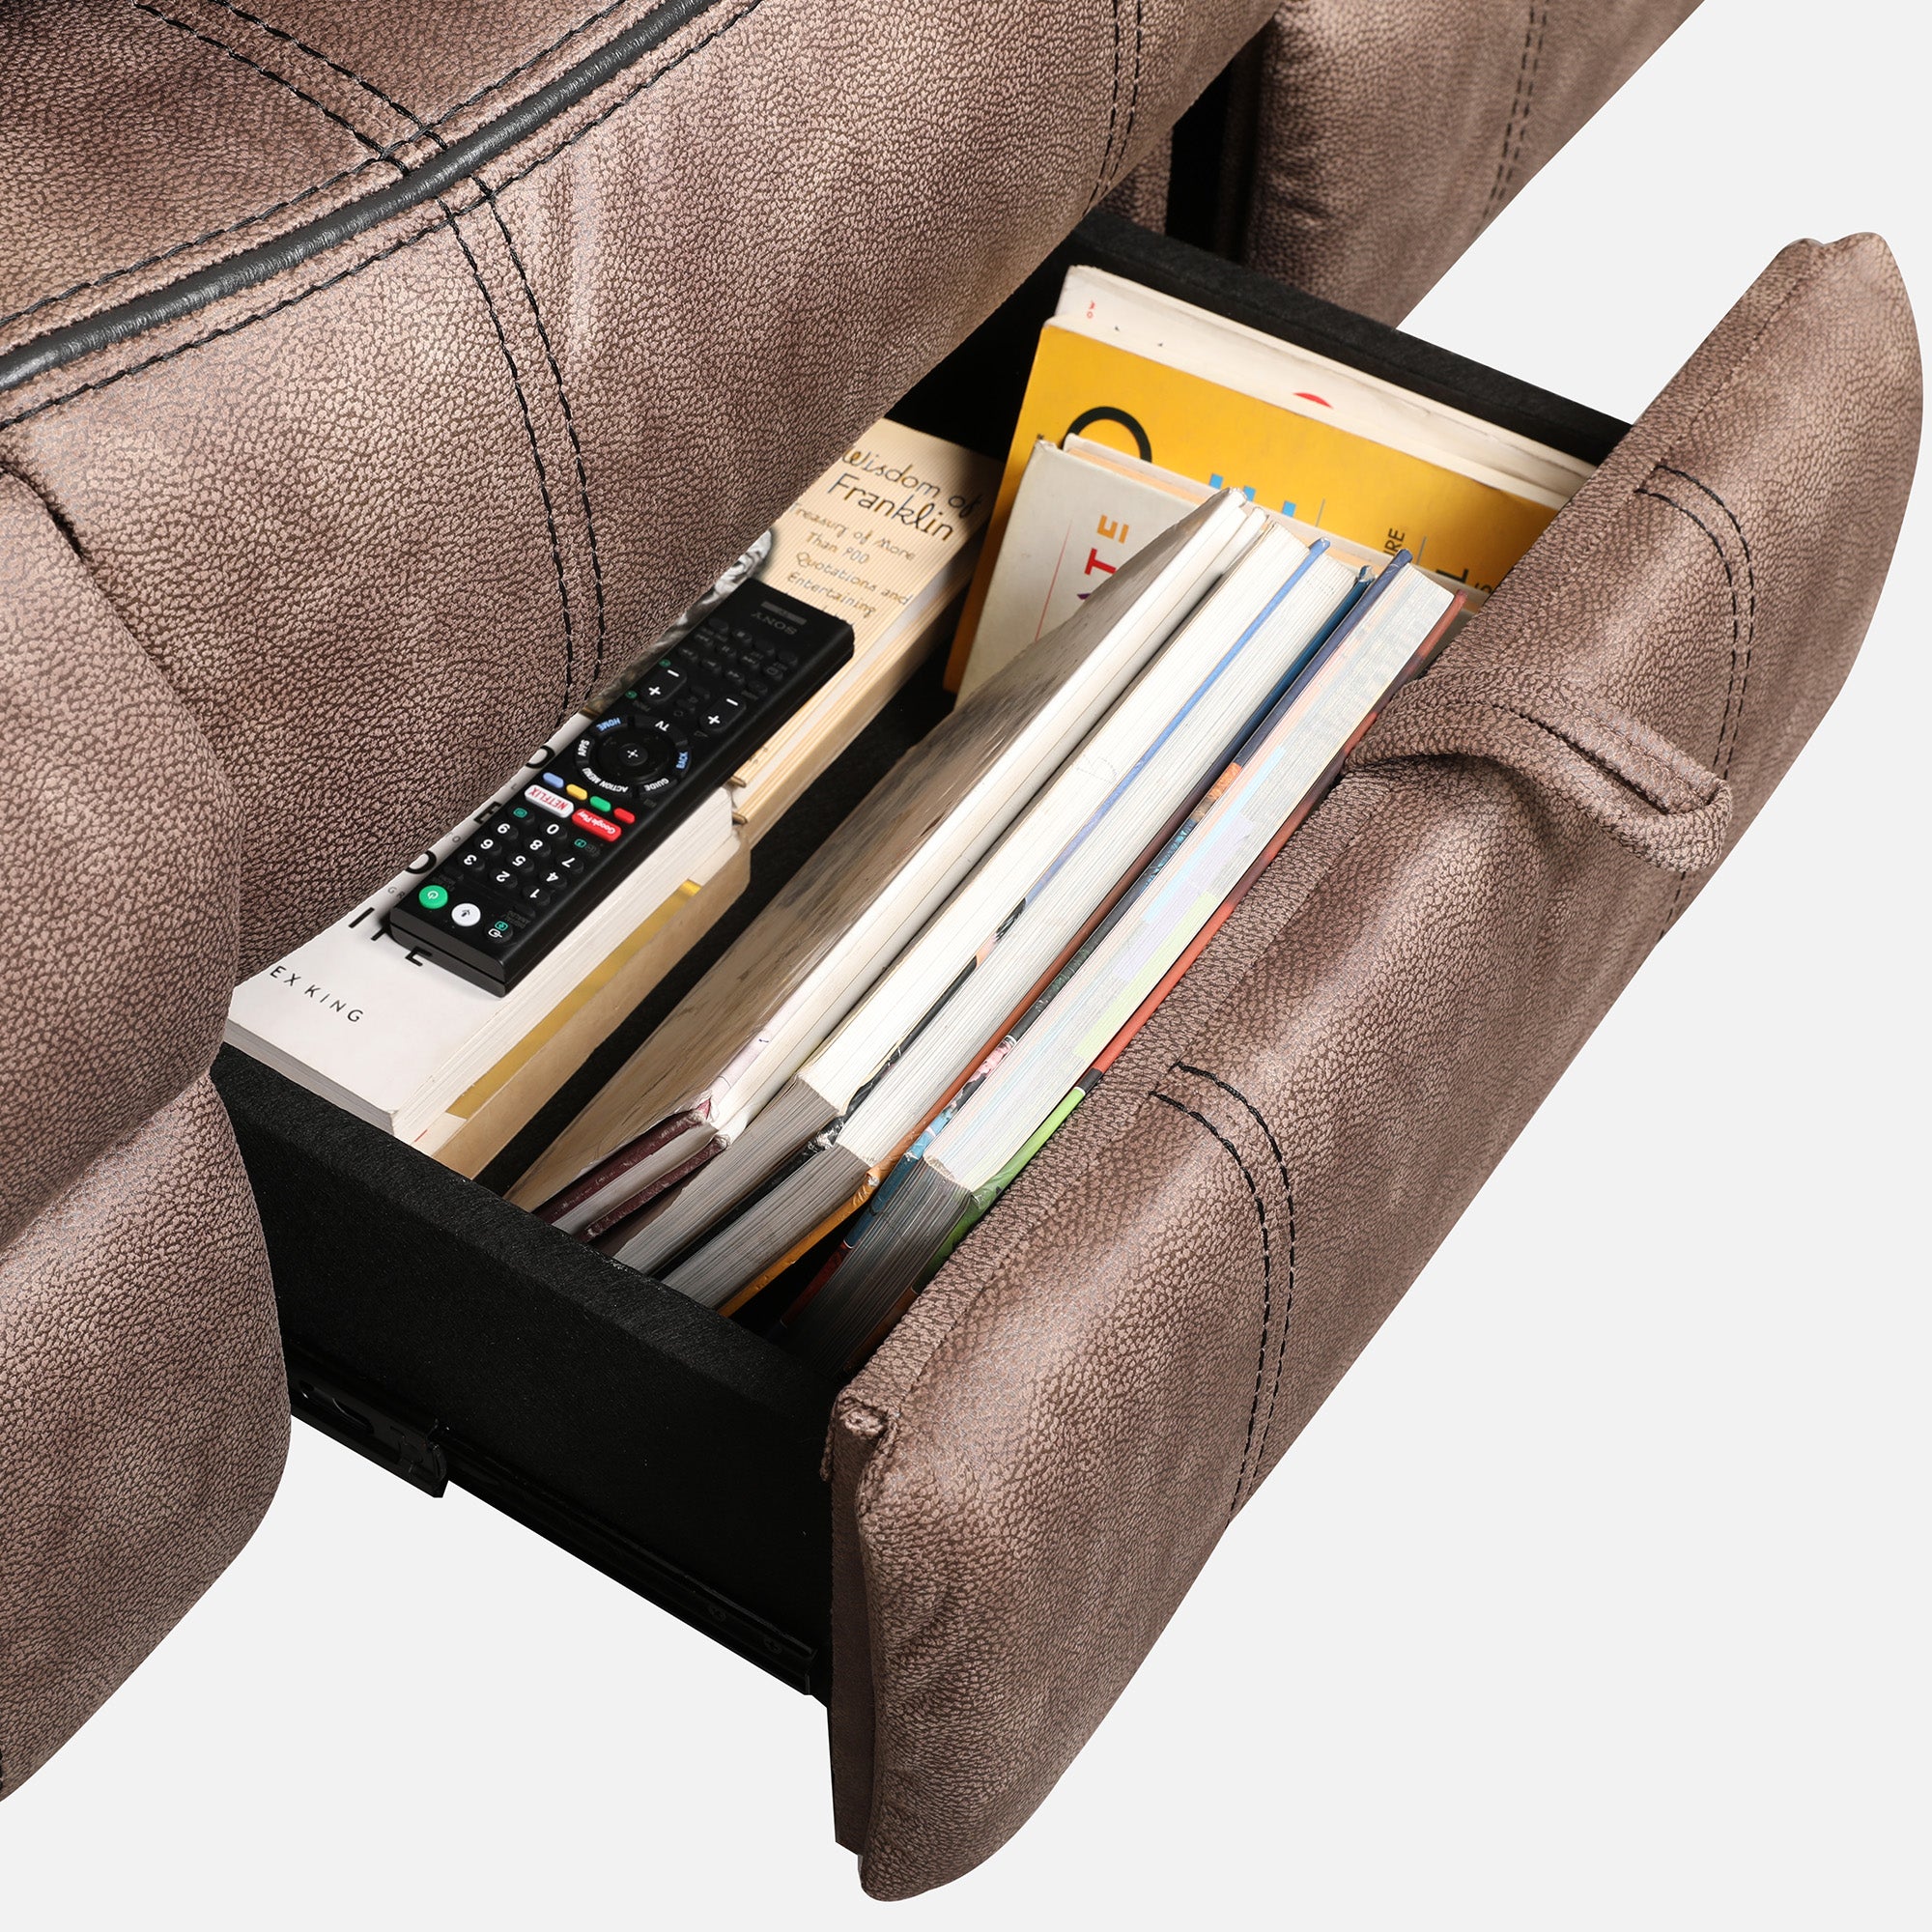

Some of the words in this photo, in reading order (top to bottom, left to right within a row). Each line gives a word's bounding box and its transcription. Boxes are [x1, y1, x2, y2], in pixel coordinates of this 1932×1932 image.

[841, 448, 942, 499] Wisdom
[948, 491, 984, 519] of
[827, 471, 954, 542] Franklin
[807, 530, 838, 554] Than
[853, 529, 872, 546] of
[873, 536, 917, 562] More
[795, 551, 877, 592] Quotations
[880, 582, 915, 607] and
[786, 571, 877, 619] Entertaining
[751, 611, 798, 636] SONY
[595, 717, 621, 732] HOME
[654, 720, 670, 732] TV
[577, 739, 590, 757] APPS
[675, 751, 689, 770] BACK
[582, 766, 603, 784] MENU
[598, 780, 629, 793] ACTION
[642, 777, 670, 792] GUIDE
[527, 786, 569, 810] NETFLIX
[577, 810, 593, 824] Play
[546, 823, 560, 836] 0
[590, 817, 616, 836] Google
[529, 838, 544, 851] 8
[463, 854, 477, 866] 3
[511, 855, 526, 867] 5
[561, 857, 576, 868] 7
[496, 870, 511, 883] 2
[546, 871, 559, 882] 4
[529, 888, 541, 899] 1
[304, 983, 364, 1023] KING
